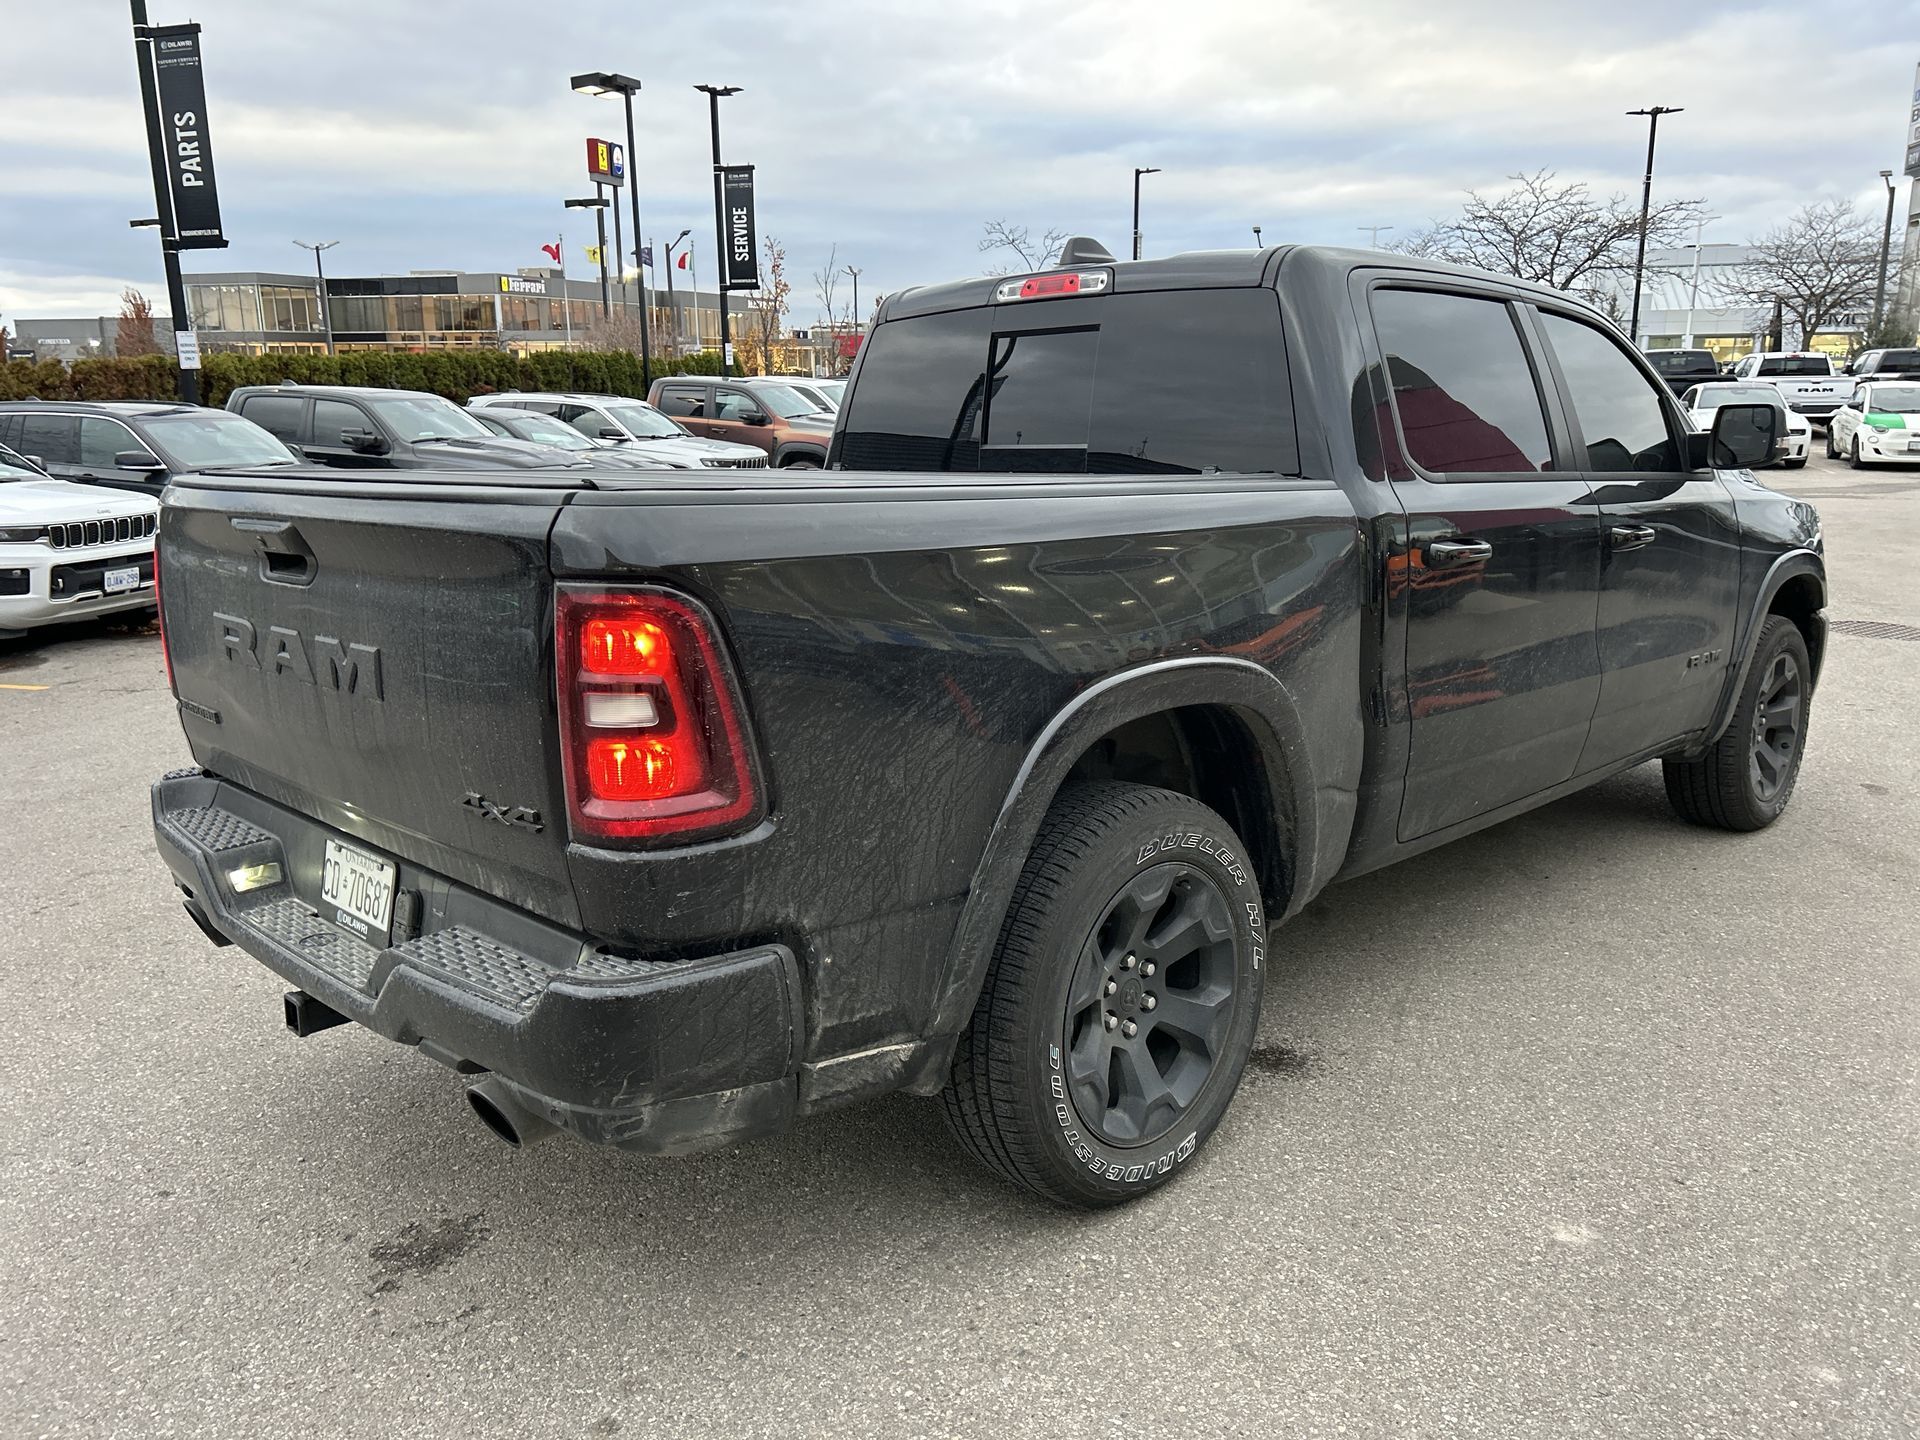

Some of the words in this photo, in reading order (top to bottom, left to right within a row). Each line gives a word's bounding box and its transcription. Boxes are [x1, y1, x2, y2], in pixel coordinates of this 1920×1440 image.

[168, 40, 192, 48] DILAWRI
[173, 111, 204, 187] PARTS
[732, 206, 750, 262] SERVICE
[508, 276, 546, 294] Ferrari
[1806, 313, 1872, 327] GMC
[212, 611, 385, 702] RAM
[323, 857, 341, 900] CD
[349, 867, 391, 925] 70687
[1136, 833, 1248, 886] DUELER
[1245, 902, 1264, 970] H/L
[342, 913, 369, 935] DILAWRI
[1050, 1043, 1197, 1183] BRIDGESTONE
